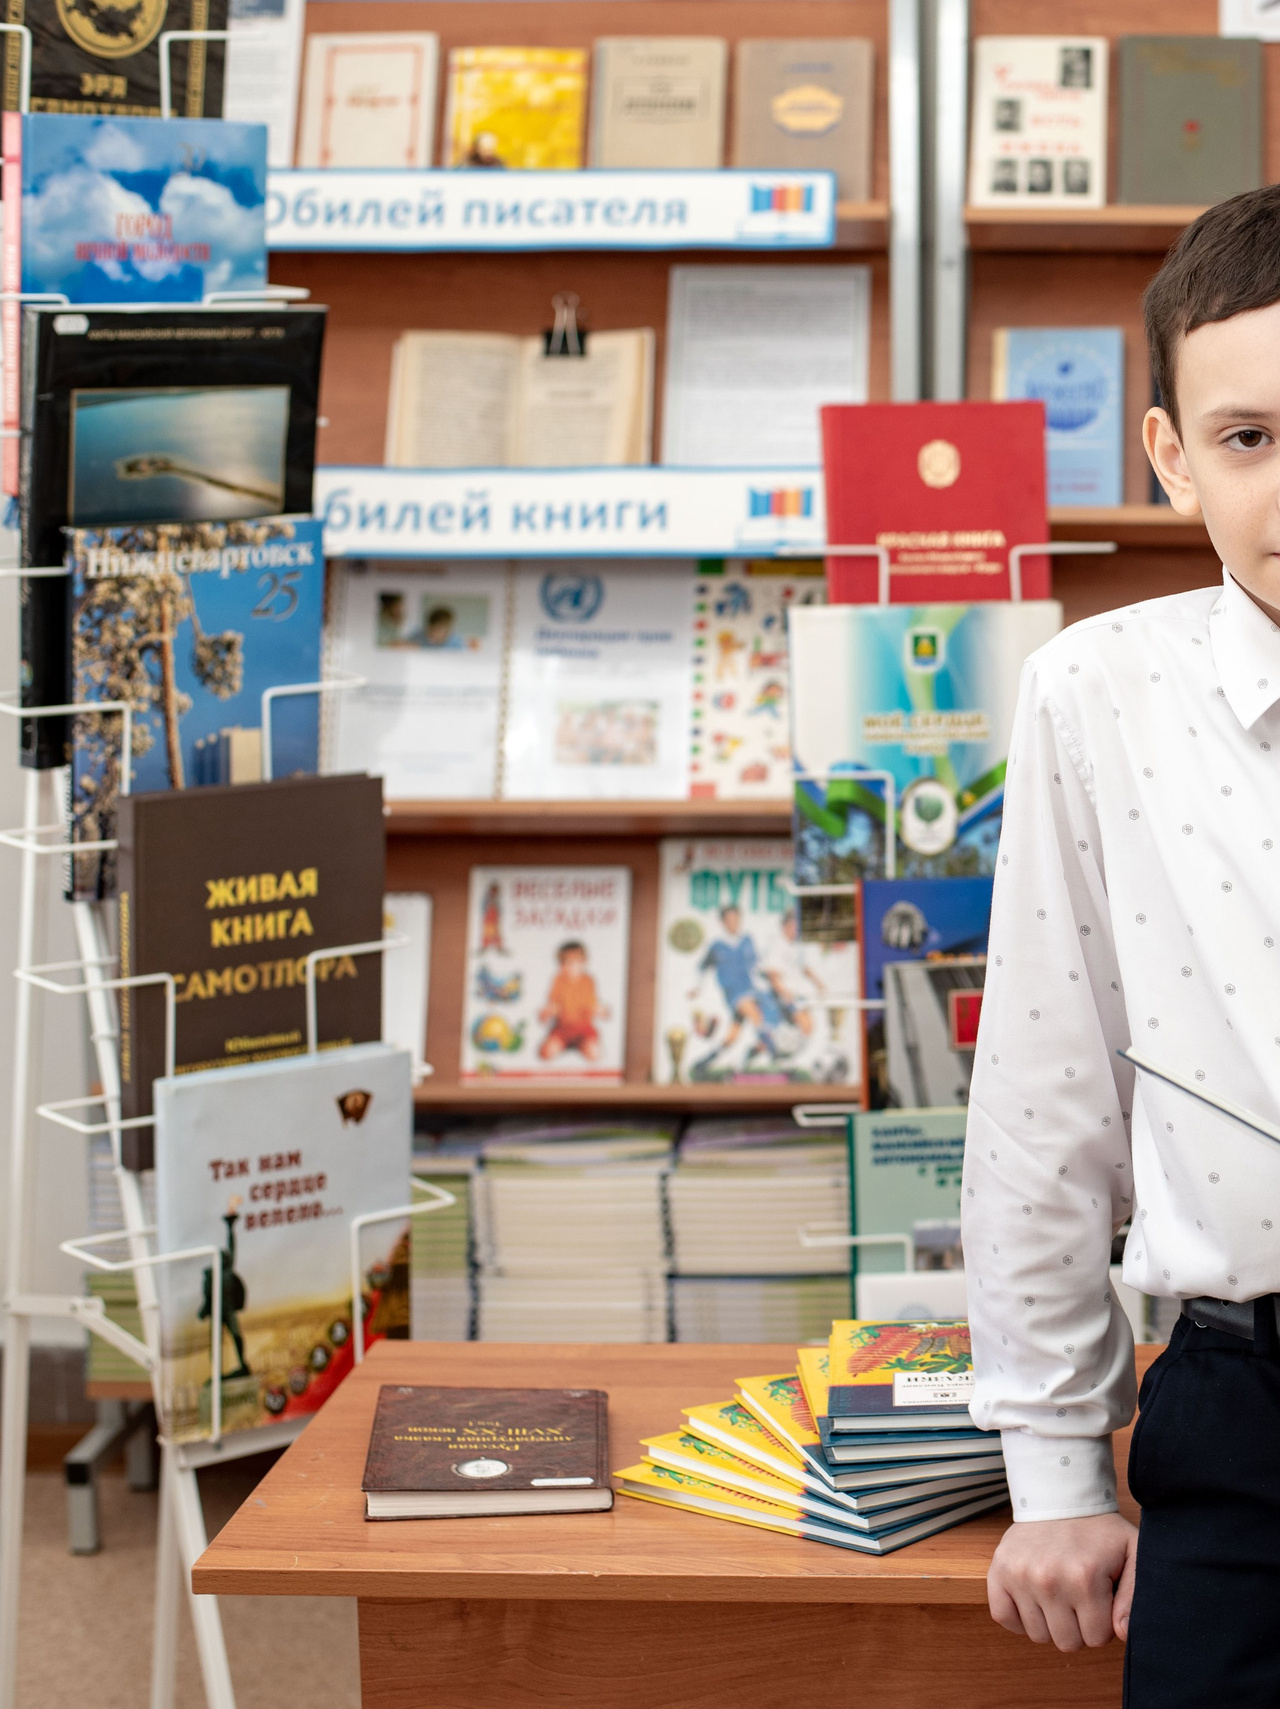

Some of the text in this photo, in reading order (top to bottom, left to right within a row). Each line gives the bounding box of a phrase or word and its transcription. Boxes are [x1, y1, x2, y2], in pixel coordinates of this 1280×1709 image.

[463, 196, 689, 227] писателя
[323, 488, 668, 532] билей книги
[86, 537, 315, 579] Нижневартовск
[252, 571, 302, 621] 25
[207, 868, 319, 910] ЖИВАЯ
[210, 909, 314, 948] КНИГА
[209, 1150, 302, 1182] Так нам
[249, 1174, 328, 1205] сердце
